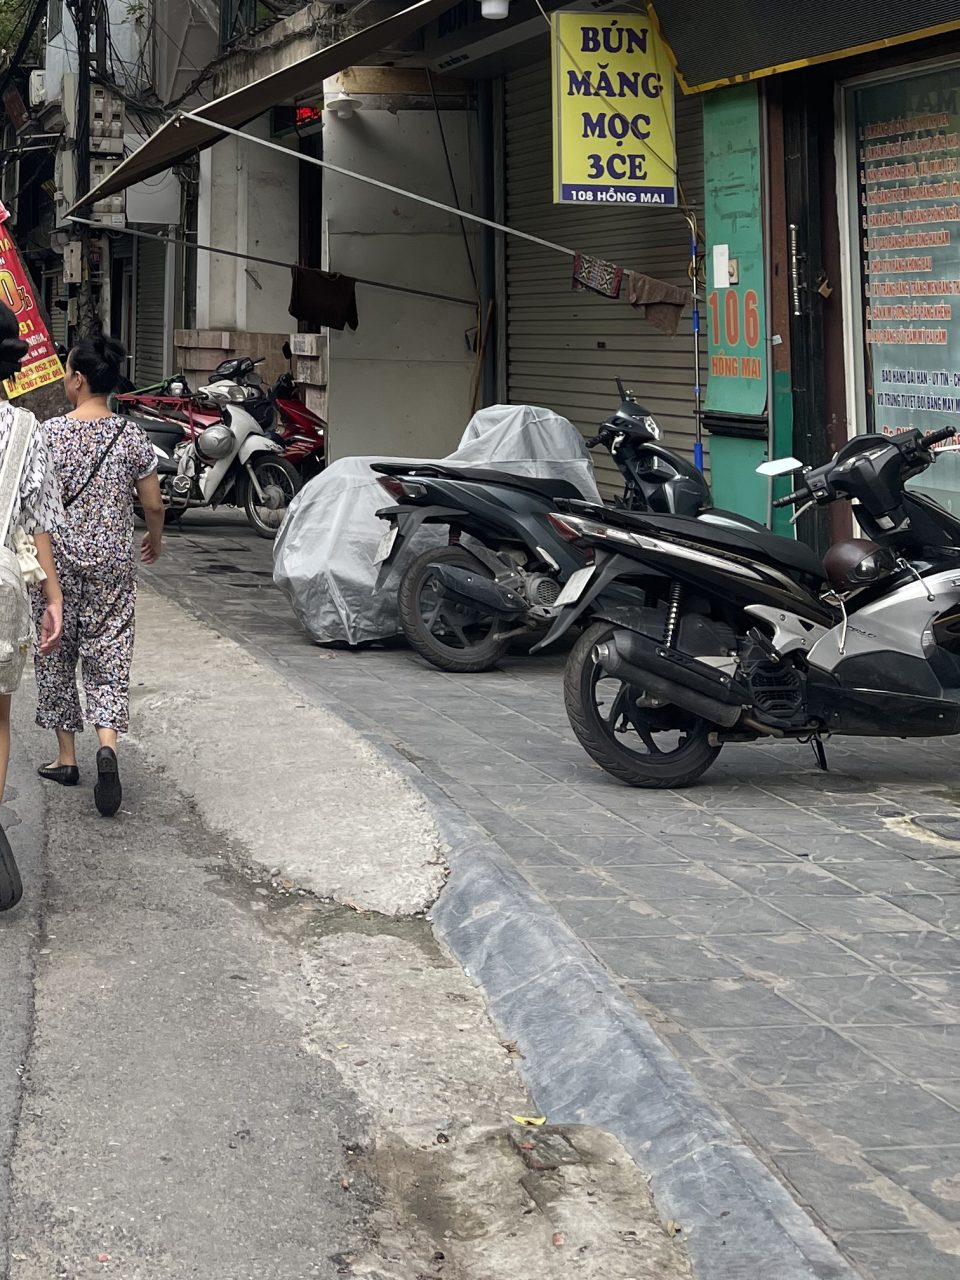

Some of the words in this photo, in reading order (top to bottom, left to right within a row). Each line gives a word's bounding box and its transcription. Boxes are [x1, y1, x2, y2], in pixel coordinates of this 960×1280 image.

[580, 20, 649, 54] BÚN
[567, 62, 664, 98] MĂNG
[581, 112, 652, 147] MỌC
[587, 153, 648, 181] 3CE
[571, 190, 594, 201] 108
[597, 188, 637, 203] HỒNG
[640, 193, 665, 204] MAI
[708, 290, 760, 349] 106
[741, 357, 762, 380] MAI
